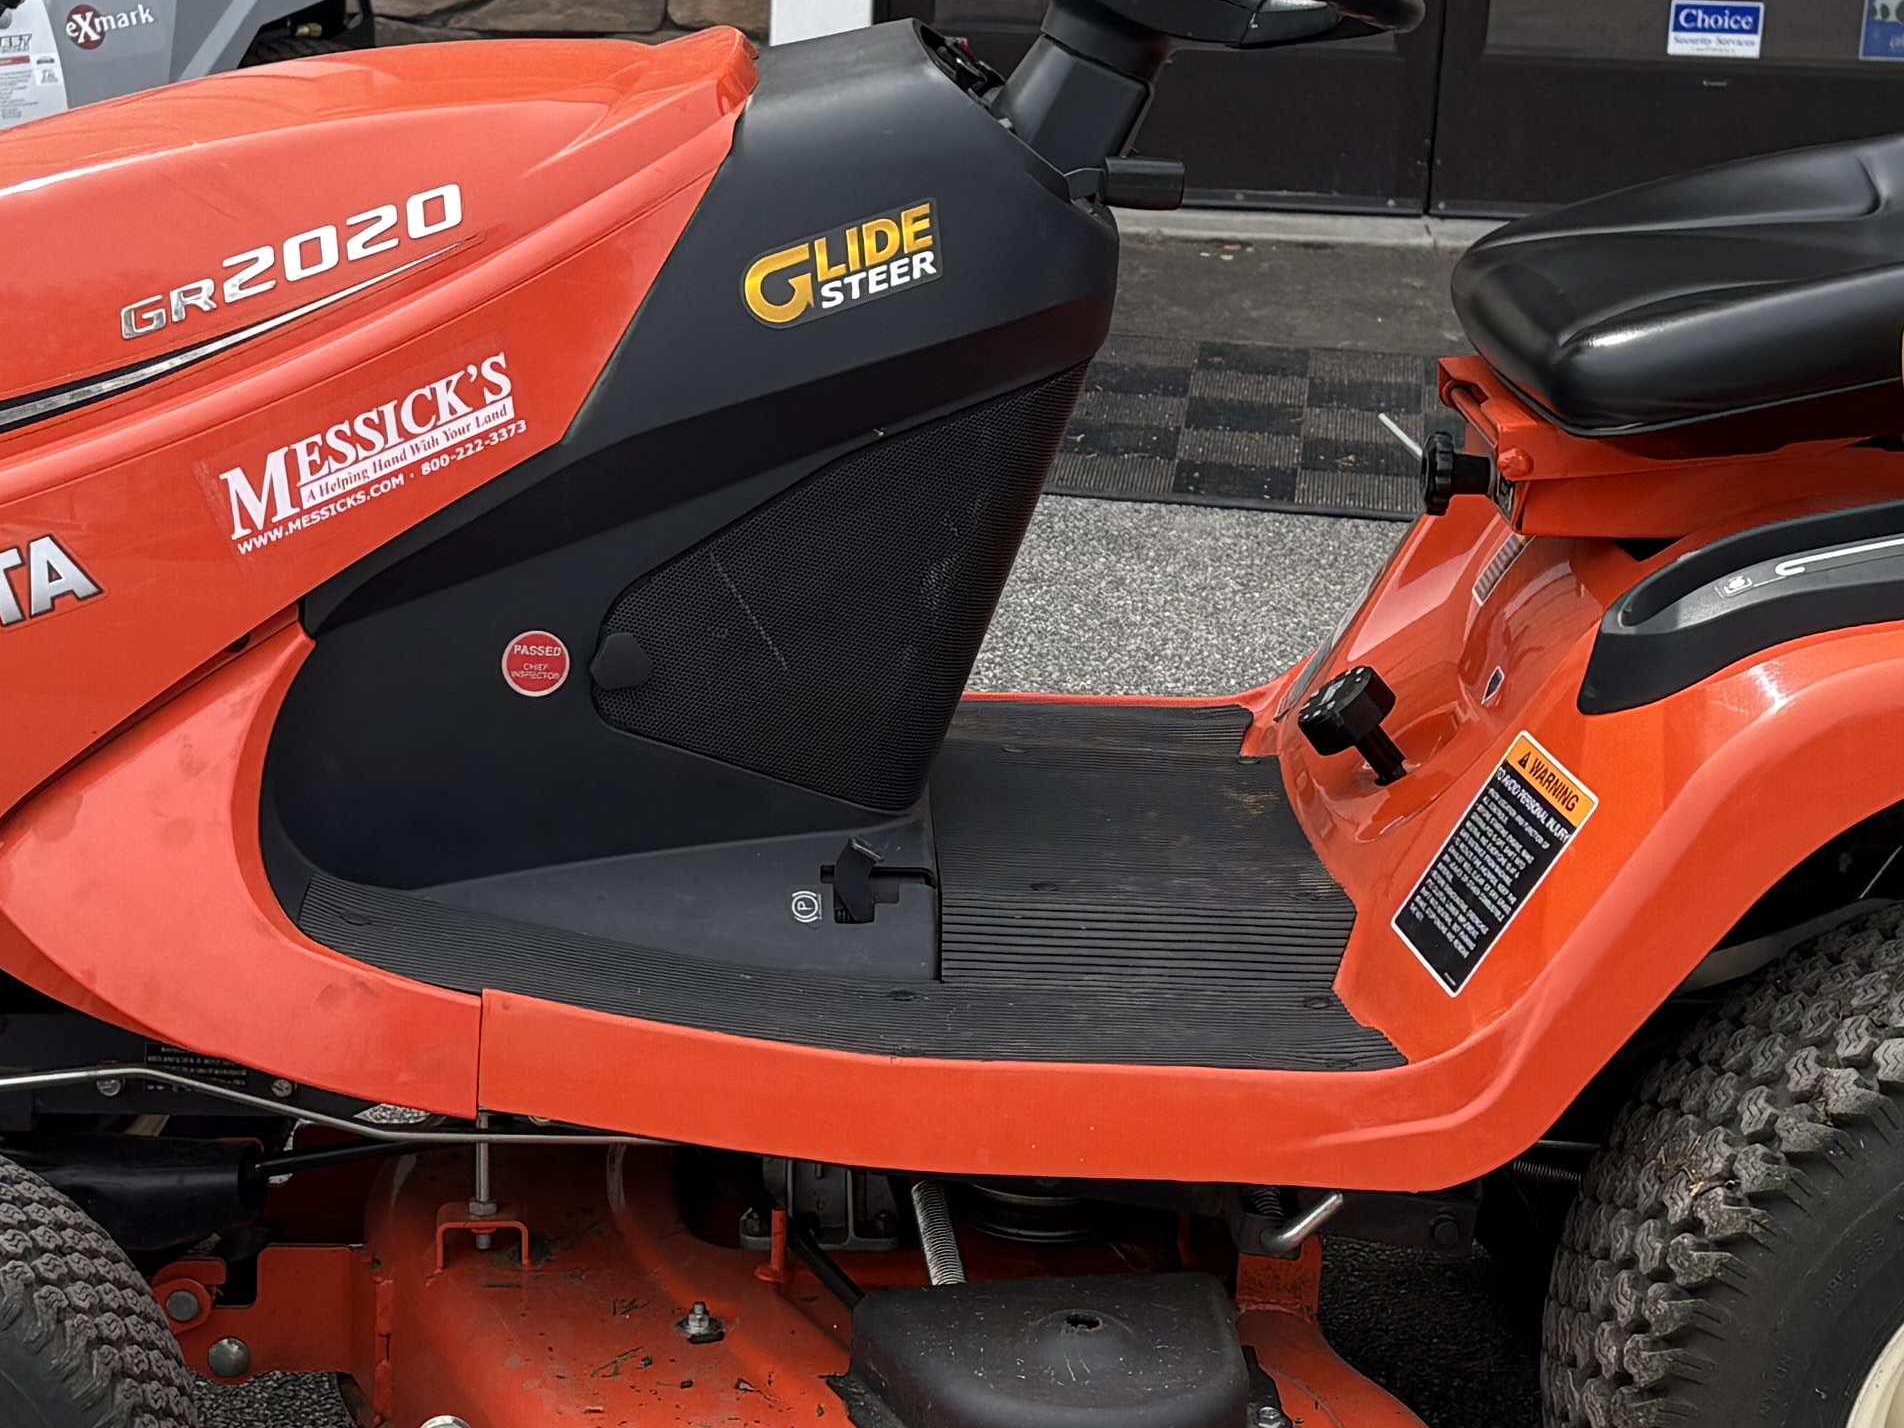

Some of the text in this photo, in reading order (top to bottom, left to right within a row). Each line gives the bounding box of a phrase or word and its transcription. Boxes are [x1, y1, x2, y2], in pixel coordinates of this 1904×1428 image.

[65, 4, 155, 44] eXmark
[1678, 8, 1754, 30] Choice
[120, 183, 463, 339] GR2020
[744, 203, 934, 323] GLIDE
[820, 250, 937, 309] STEER
[219, 354, 513, 540] MESSICK'S
[319, 468, 370, 499] Helping
[372, 451, 408, 476] Hand
[409, 435, 440, 462] With
[442, 420, 472, 450] Your
[475, 403, 508, 429] Land
[237, 419, 527, 555] WWW.MESSICKS.COM 800-222-3373
[513, 644, 562, 657] PASSED
[1526, 757, 1581, 814] WARNING
